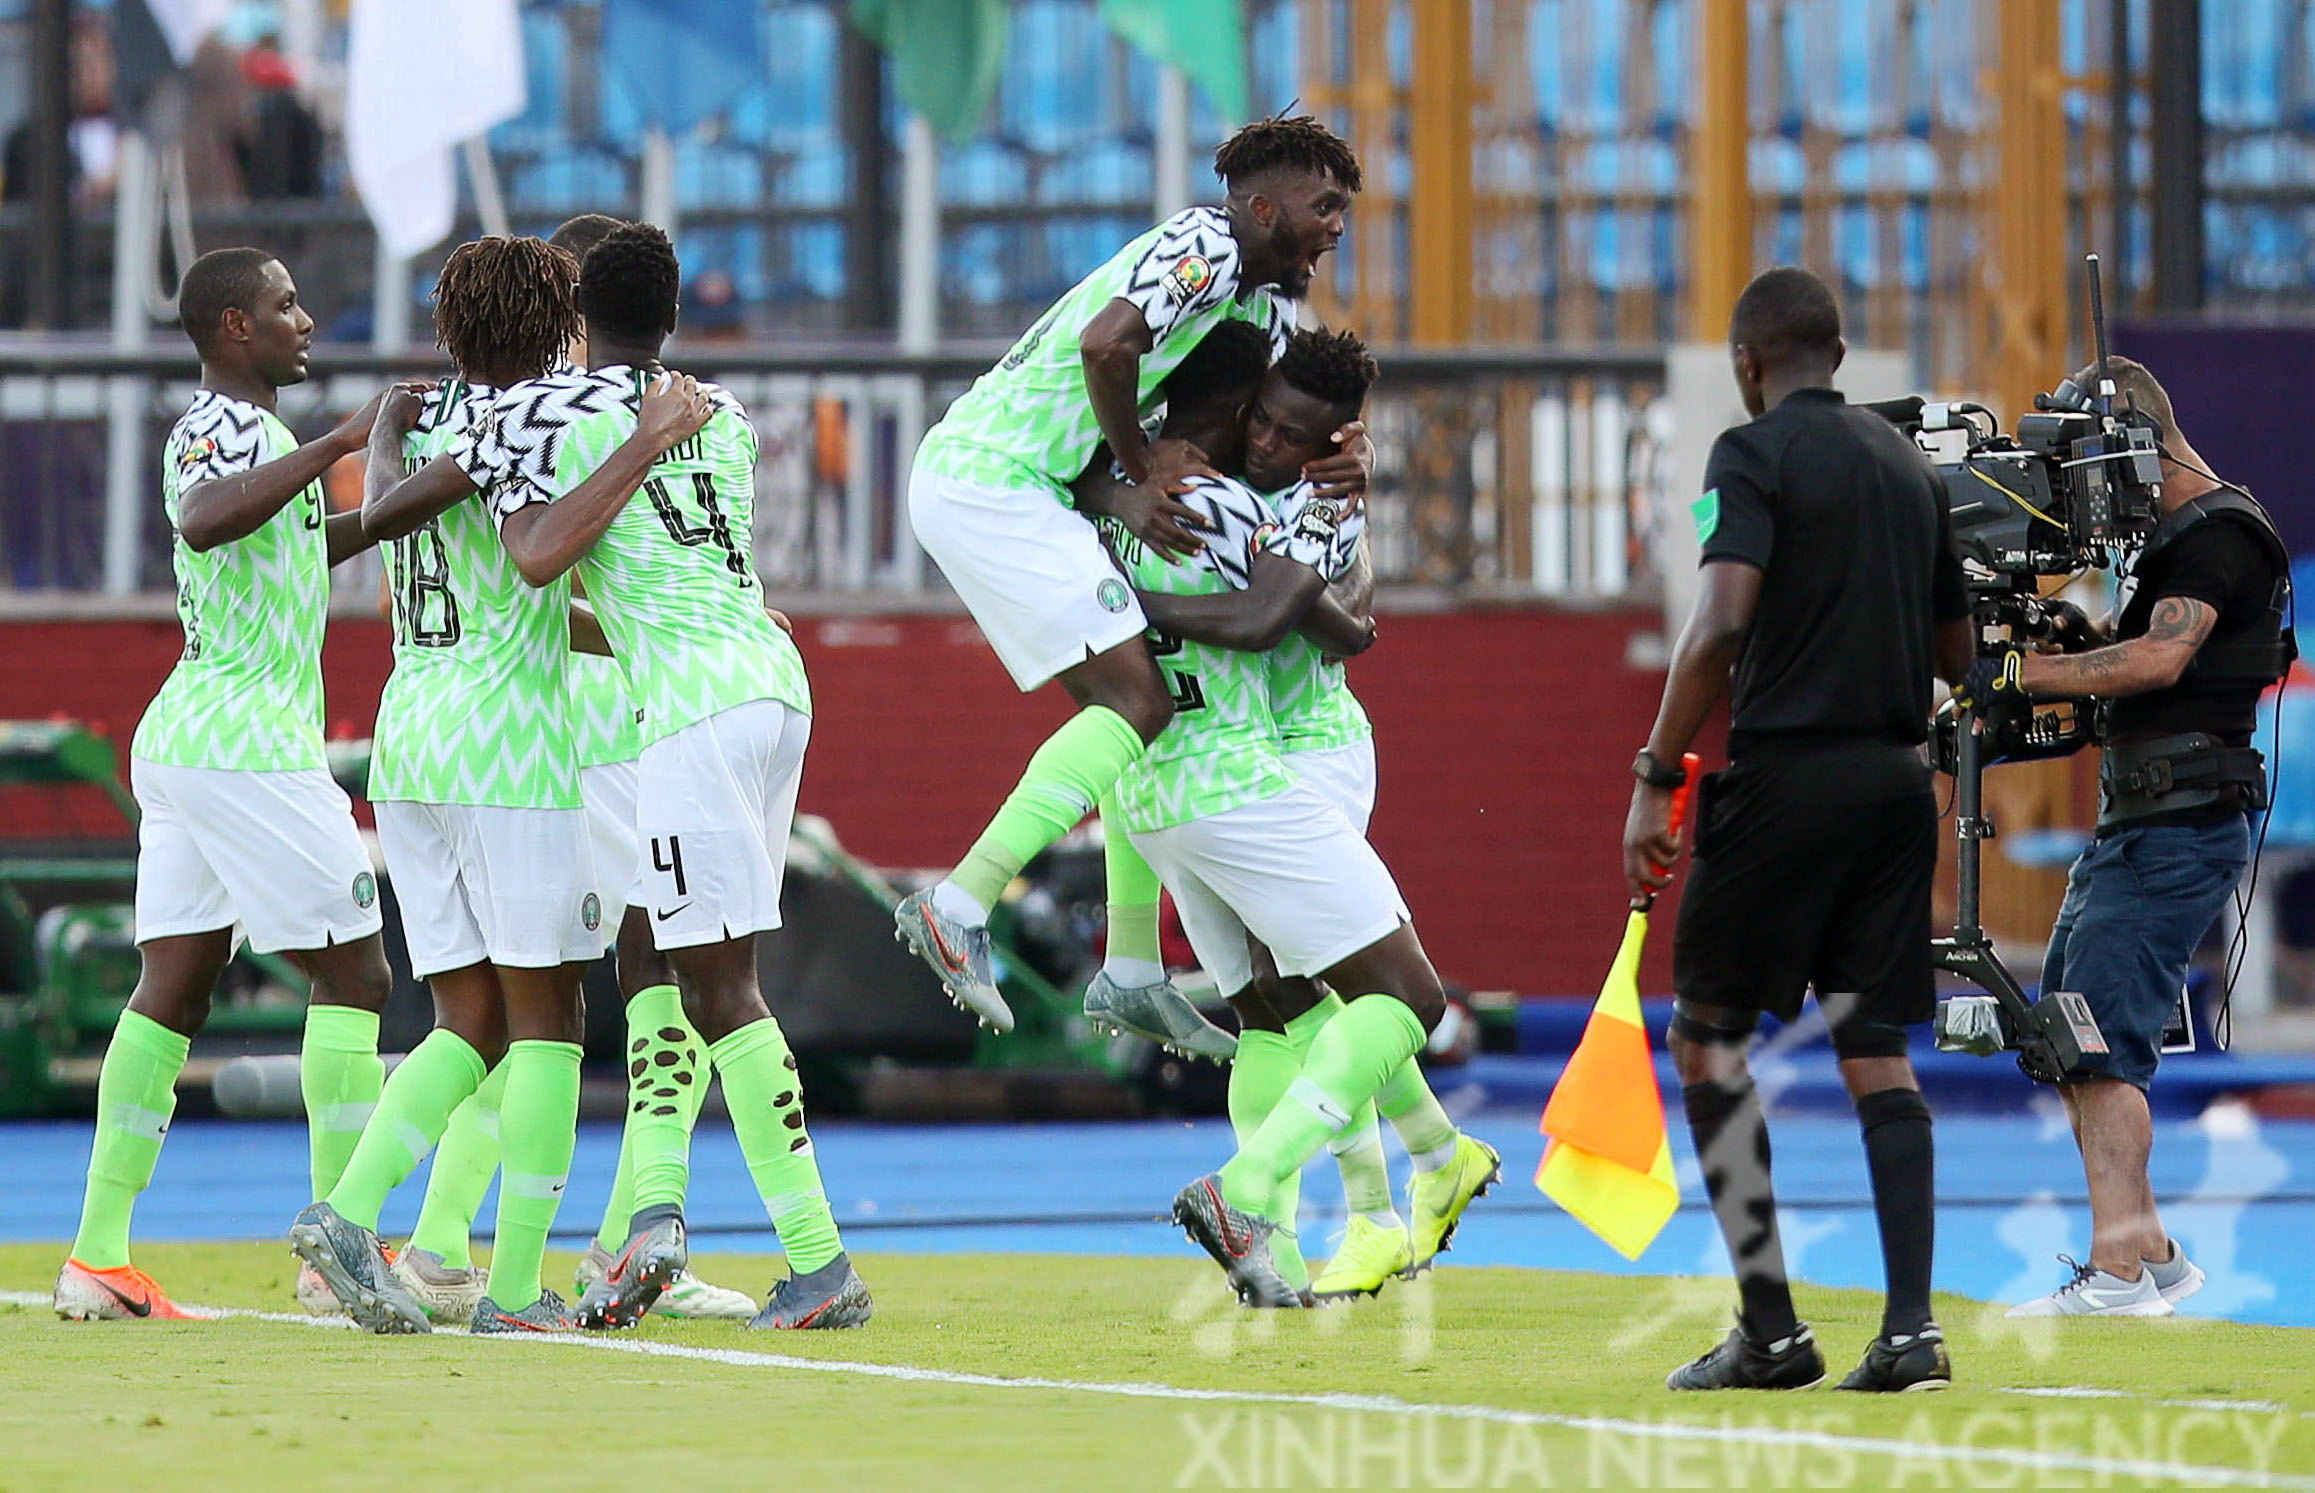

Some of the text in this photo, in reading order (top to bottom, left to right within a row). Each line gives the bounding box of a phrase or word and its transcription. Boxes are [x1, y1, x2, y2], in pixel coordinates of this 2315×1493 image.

[394, 515, 460, 647] 18
[643, 473, 752, 588] 4
[651, 835, 687, 896] 4
